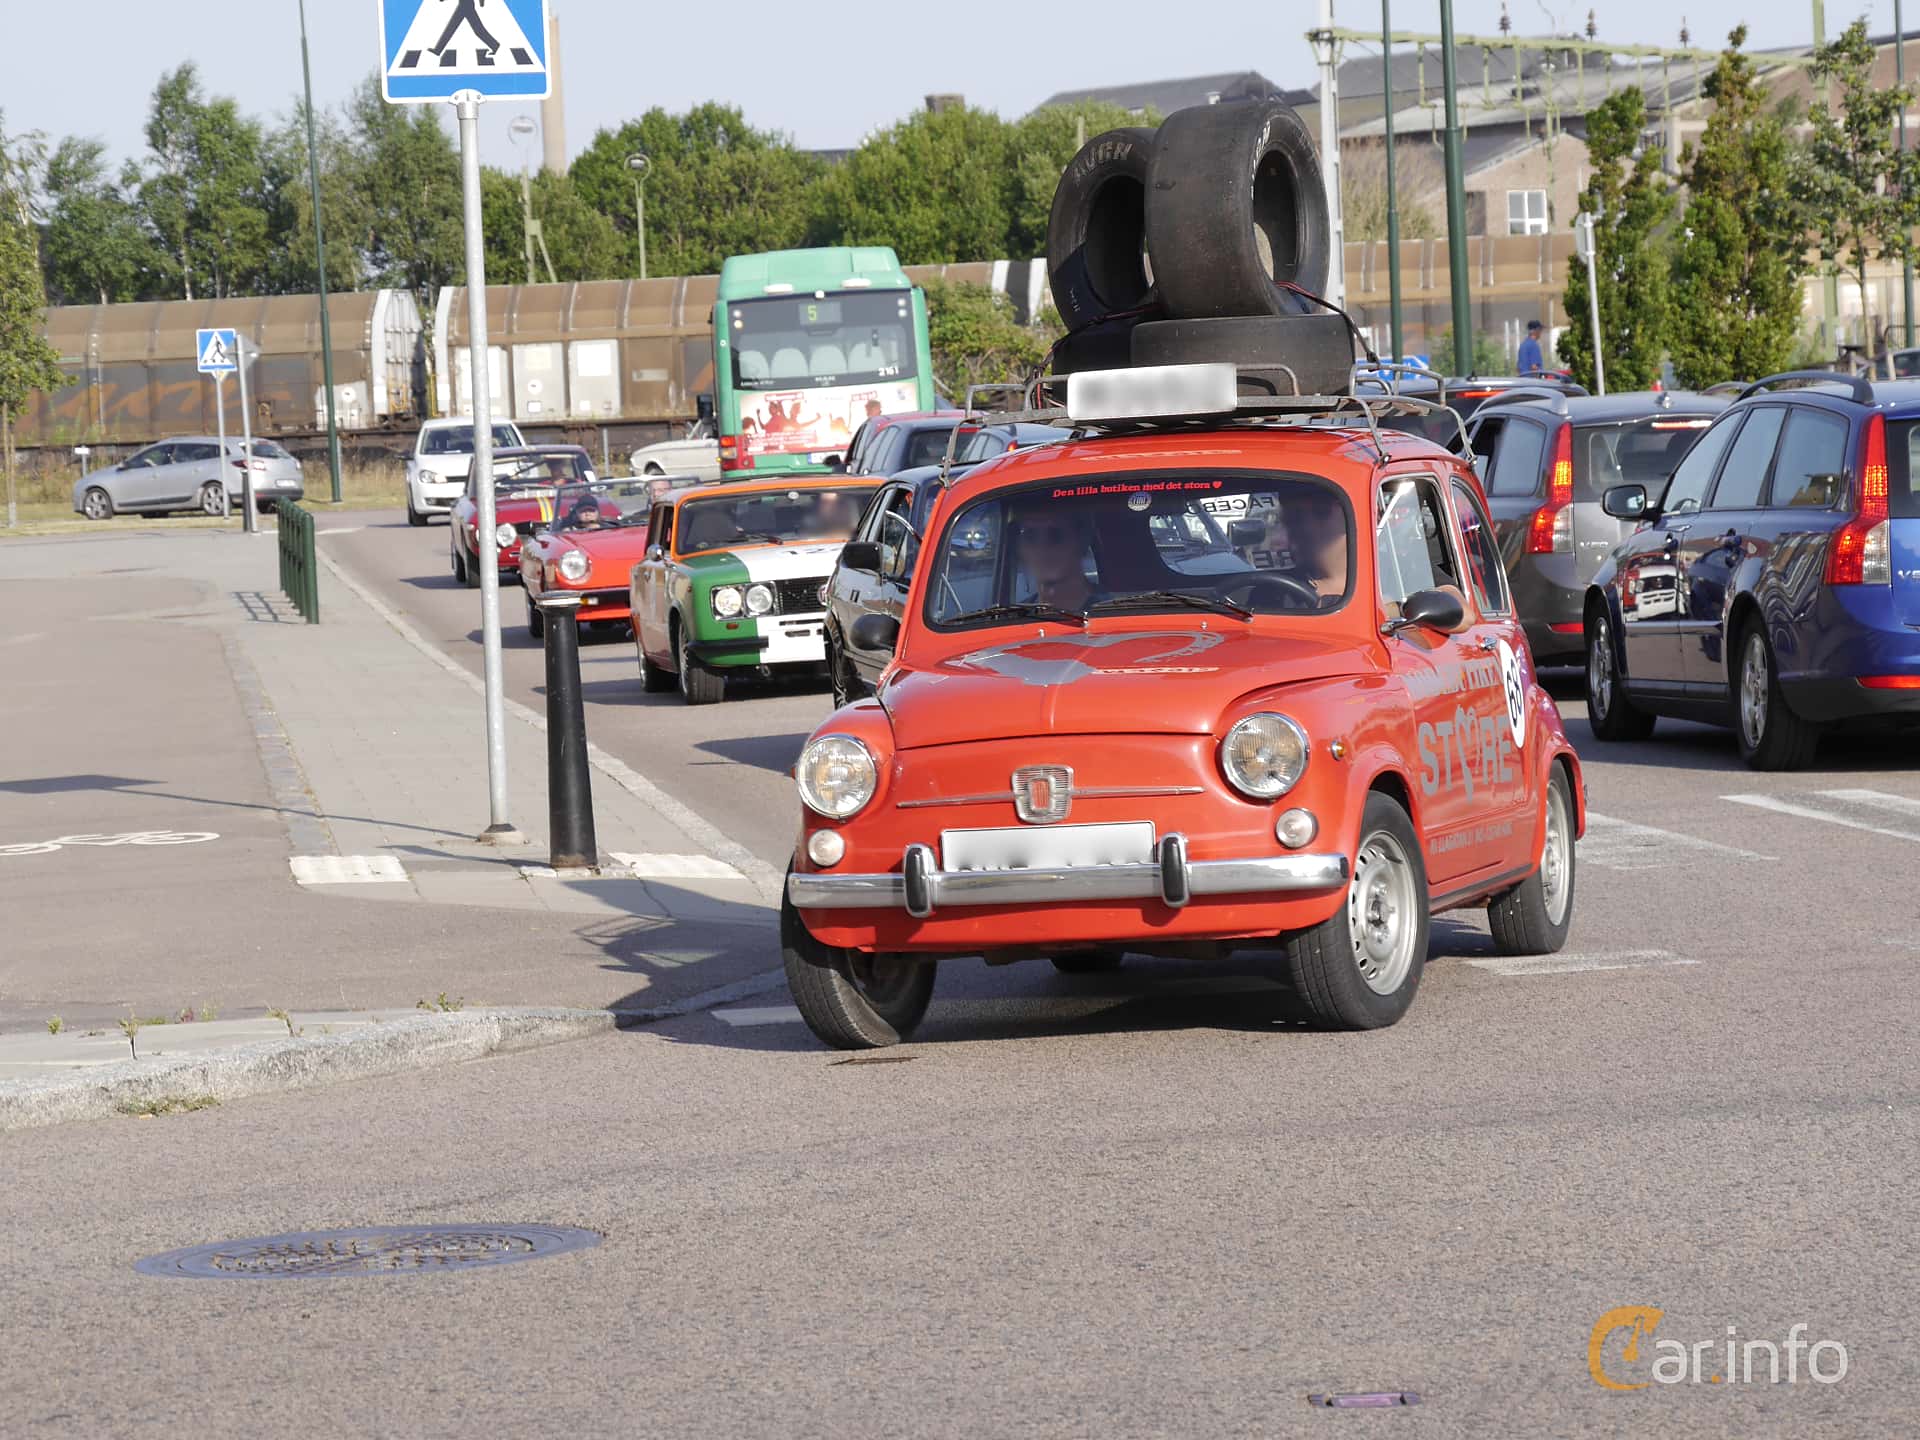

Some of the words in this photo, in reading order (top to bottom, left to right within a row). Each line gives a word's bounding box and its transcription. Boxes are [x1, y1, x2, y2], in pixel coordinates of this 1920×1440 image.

[807, 305, 817, 321] 5
[1052, 488, 1075, 498] Den
[1077, 485, 1099, 496] lilla
[1143, 481, 1165, 491] med
[1166, 481, 1183, 490] det
[1184, 481, 1211, 490] stora
[1507, 658, 1522, 728] 68
